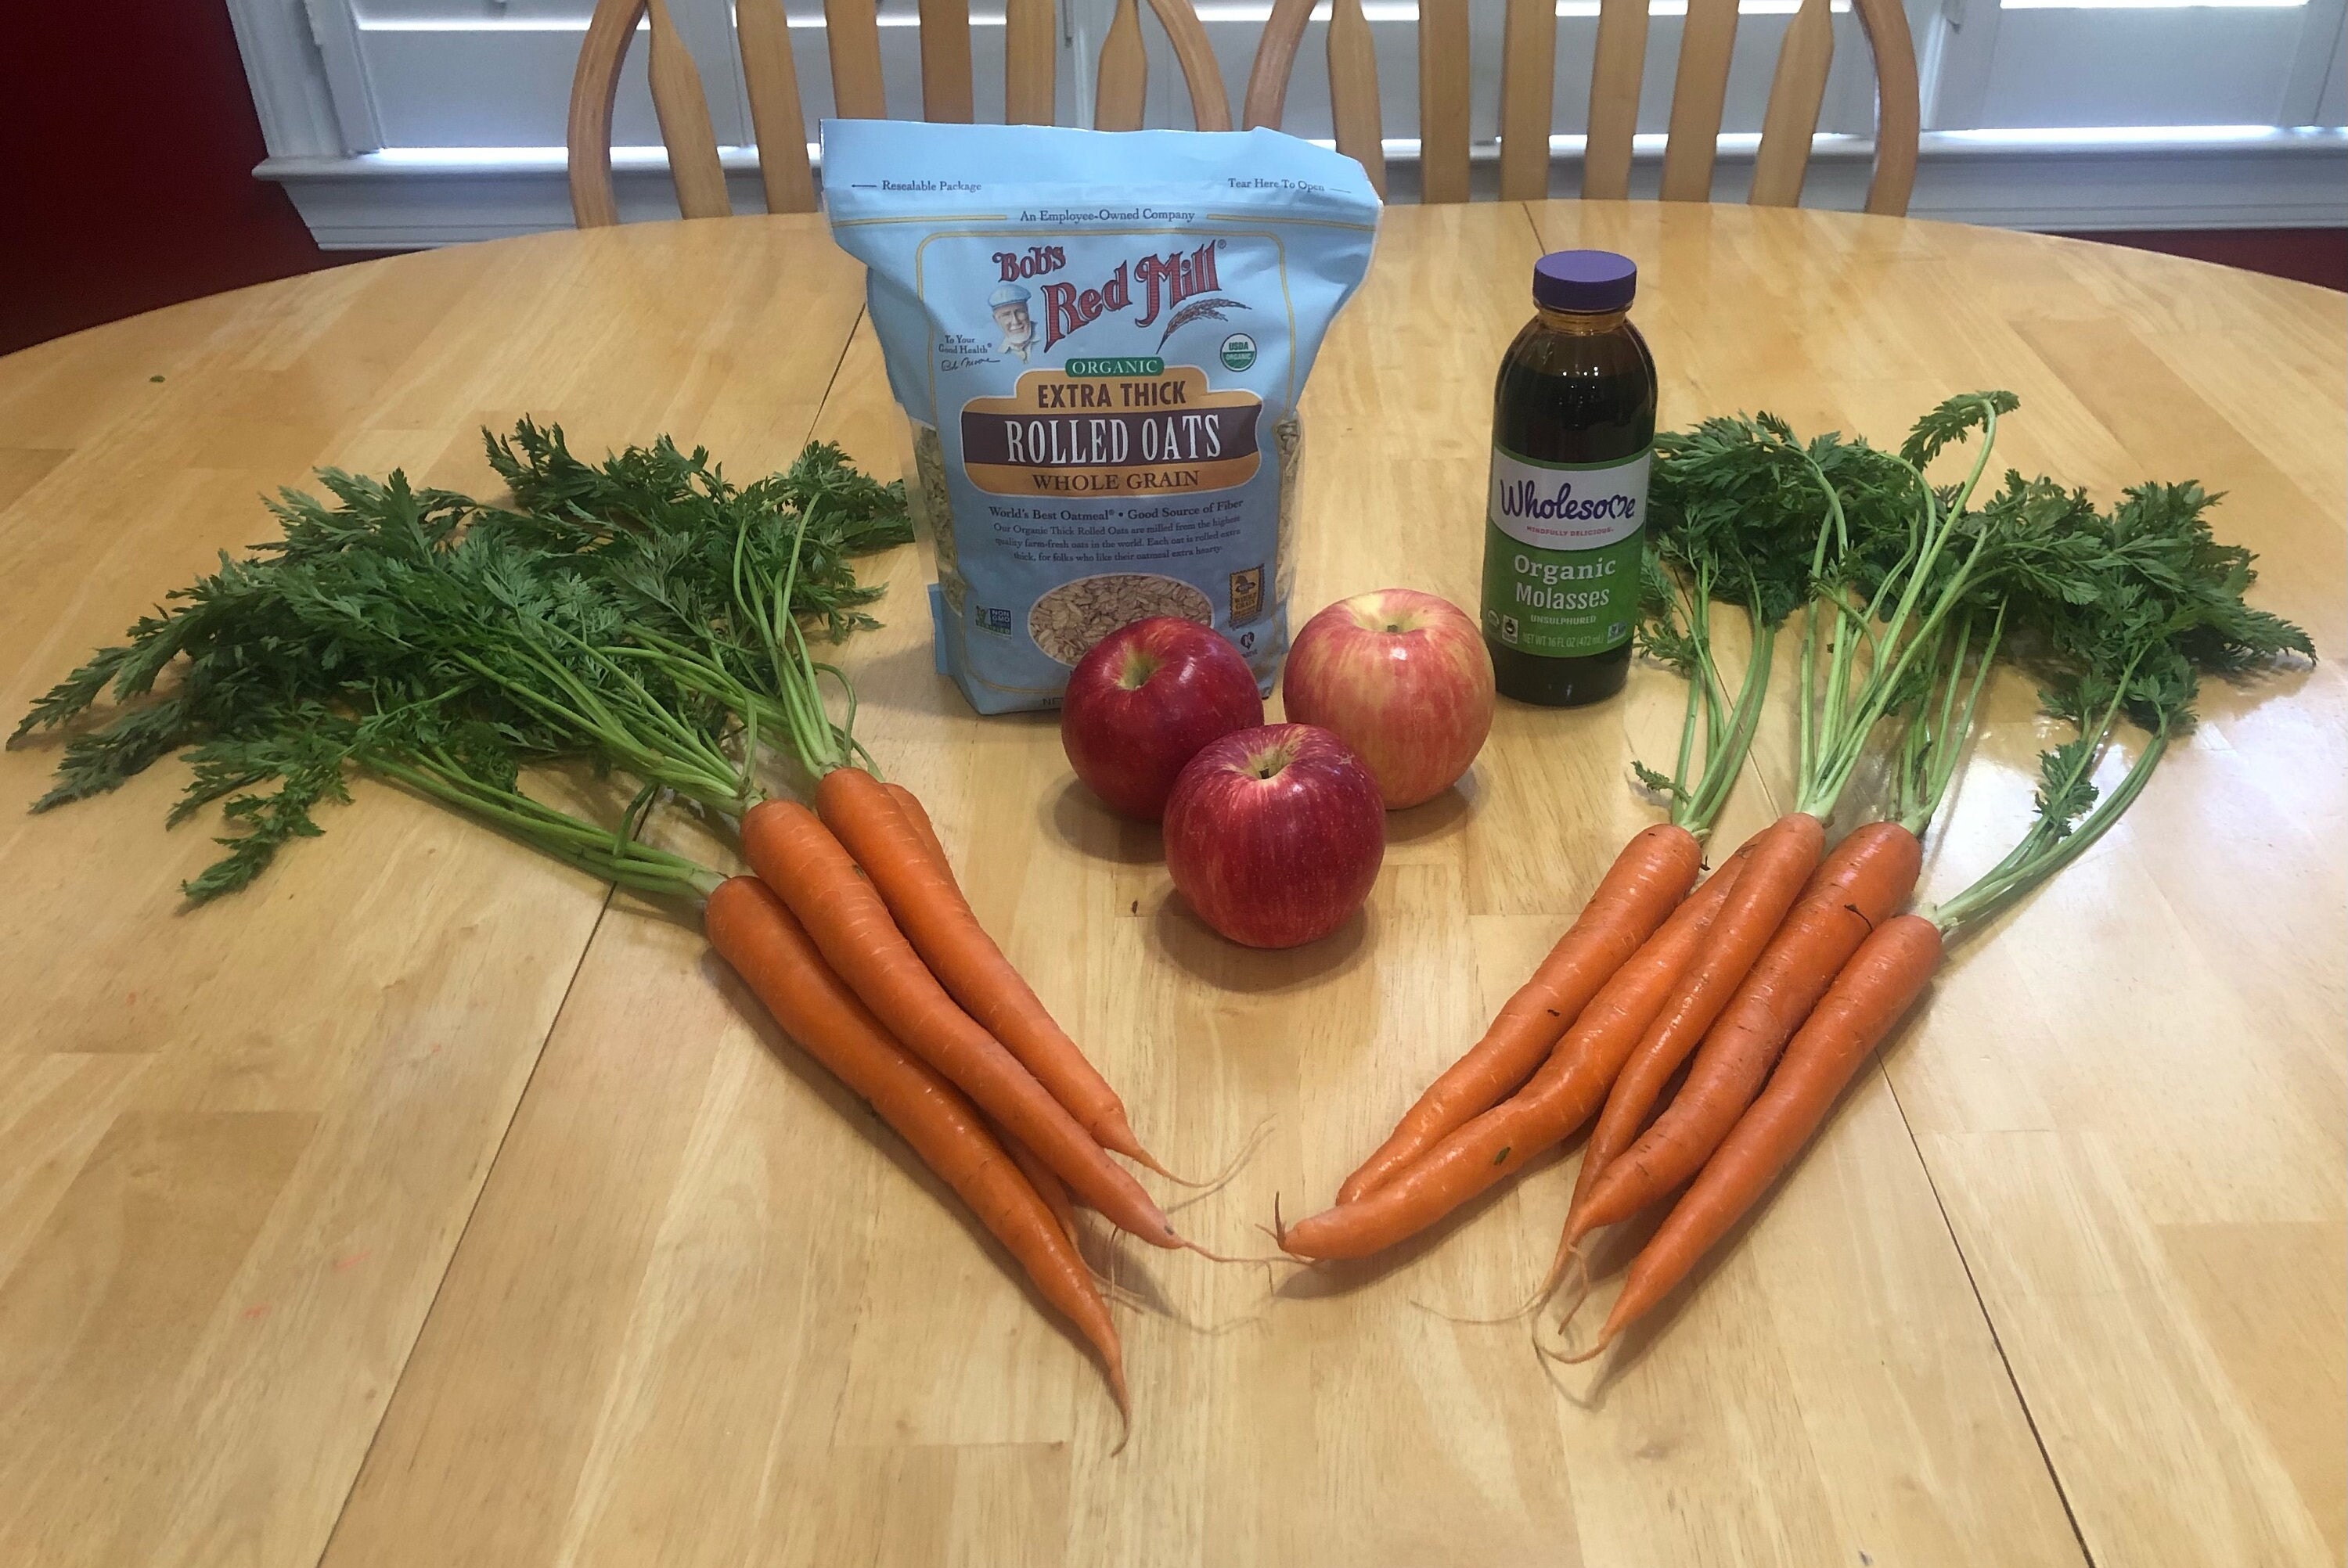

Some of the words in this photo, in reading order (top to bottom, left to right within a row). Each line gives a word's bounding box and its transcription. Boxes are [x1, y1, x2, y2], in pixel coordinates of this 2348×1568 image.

[882, 179, 936, 191] Resealable
[939, 181, 981, 192] Package
[1227, 178, 1251, 189] Tear
[1254, 178, 1279, 189] Here
[1281, 179, 1295, 189] To
[1298, 180, 1325, 192] Open
[1020, 210, 1036, 221] An
[1039, 208, 1140, 225] Employee-Owned
[1143, 207, 1196, 223] Company
[992, 245, 1067, 282] Bob's
[1040, 259, 1133, 354] Red
[944, 334, 955, 344] To
[956, 334, 975, 344] Your
[1229, 341, 1249, 351] USDA
[938, 343, 958, 354] Good
[1071, 358, 1158, 376] ORGANIC
[1037, 383, 1112, 408] EXTRA
[1120, 380, 1187, 408] THICK
[1004, 419, 1129, 465] ROLLED
[1141, 414, 1221, 462] OATS
[1032, 473, 1120, 491] WHOLE
[1125, 470, 1200, 490] GRAIN
[1500, 479, 1636, 520] Wholesome
[989, 506, 1029, 520] World's
[1032, 509, 1057, 520] Best
[1127, 508, 1159, 520] Good
[1161, 506, 1201, 518] Source
[1202, 502, 1215, 513] of
[1216, 499, 1244, 512] Fiber
[993, 522, 1011, 533] Our
[1013, 524, 1048, 536] Organic
[1050, 526, 1075, 535] Thick
[1078, 527, 1105, 536] Rolled
[1107, 525, 1129, 535] Oats
[1147, 522, 1173, 534] milled
[1176, 522, 1196, 531] from
[1197, 520, 1211, 528] the
[1526, 525, 1568, 537] MINDFULLY
[995, 538, 1023, 548] quality
[1025, 538, 1069, 548] farm-fresh
[1091, 540, 1100, 548] in
[1102, 540, 1115, 548] the
[1147, 535, 1169, 547] Each
[1171, 536, 1184, 545] oat
[1186, 534, 1194, 543] is
[1194, 530, 1219, 542] rolled
[1220, 528, 1241, 538] extra
[1039, 552, 1052, 562] for
[1053, 552, 1074, 563] folks
[1075, 552, 1094, 562] who
[1096, 552, 1113, 562] like
[1115, 552, 1135, 561] their
[1136, 549, 1170, 560] oatmeal
[1172, 549, 1194, 558] extra
[1514, 554, 1617, 585] Organic
[1515, 581, 1610, 610] Molasses
[1530, 613, 1597, 626] UNSULPHURED
